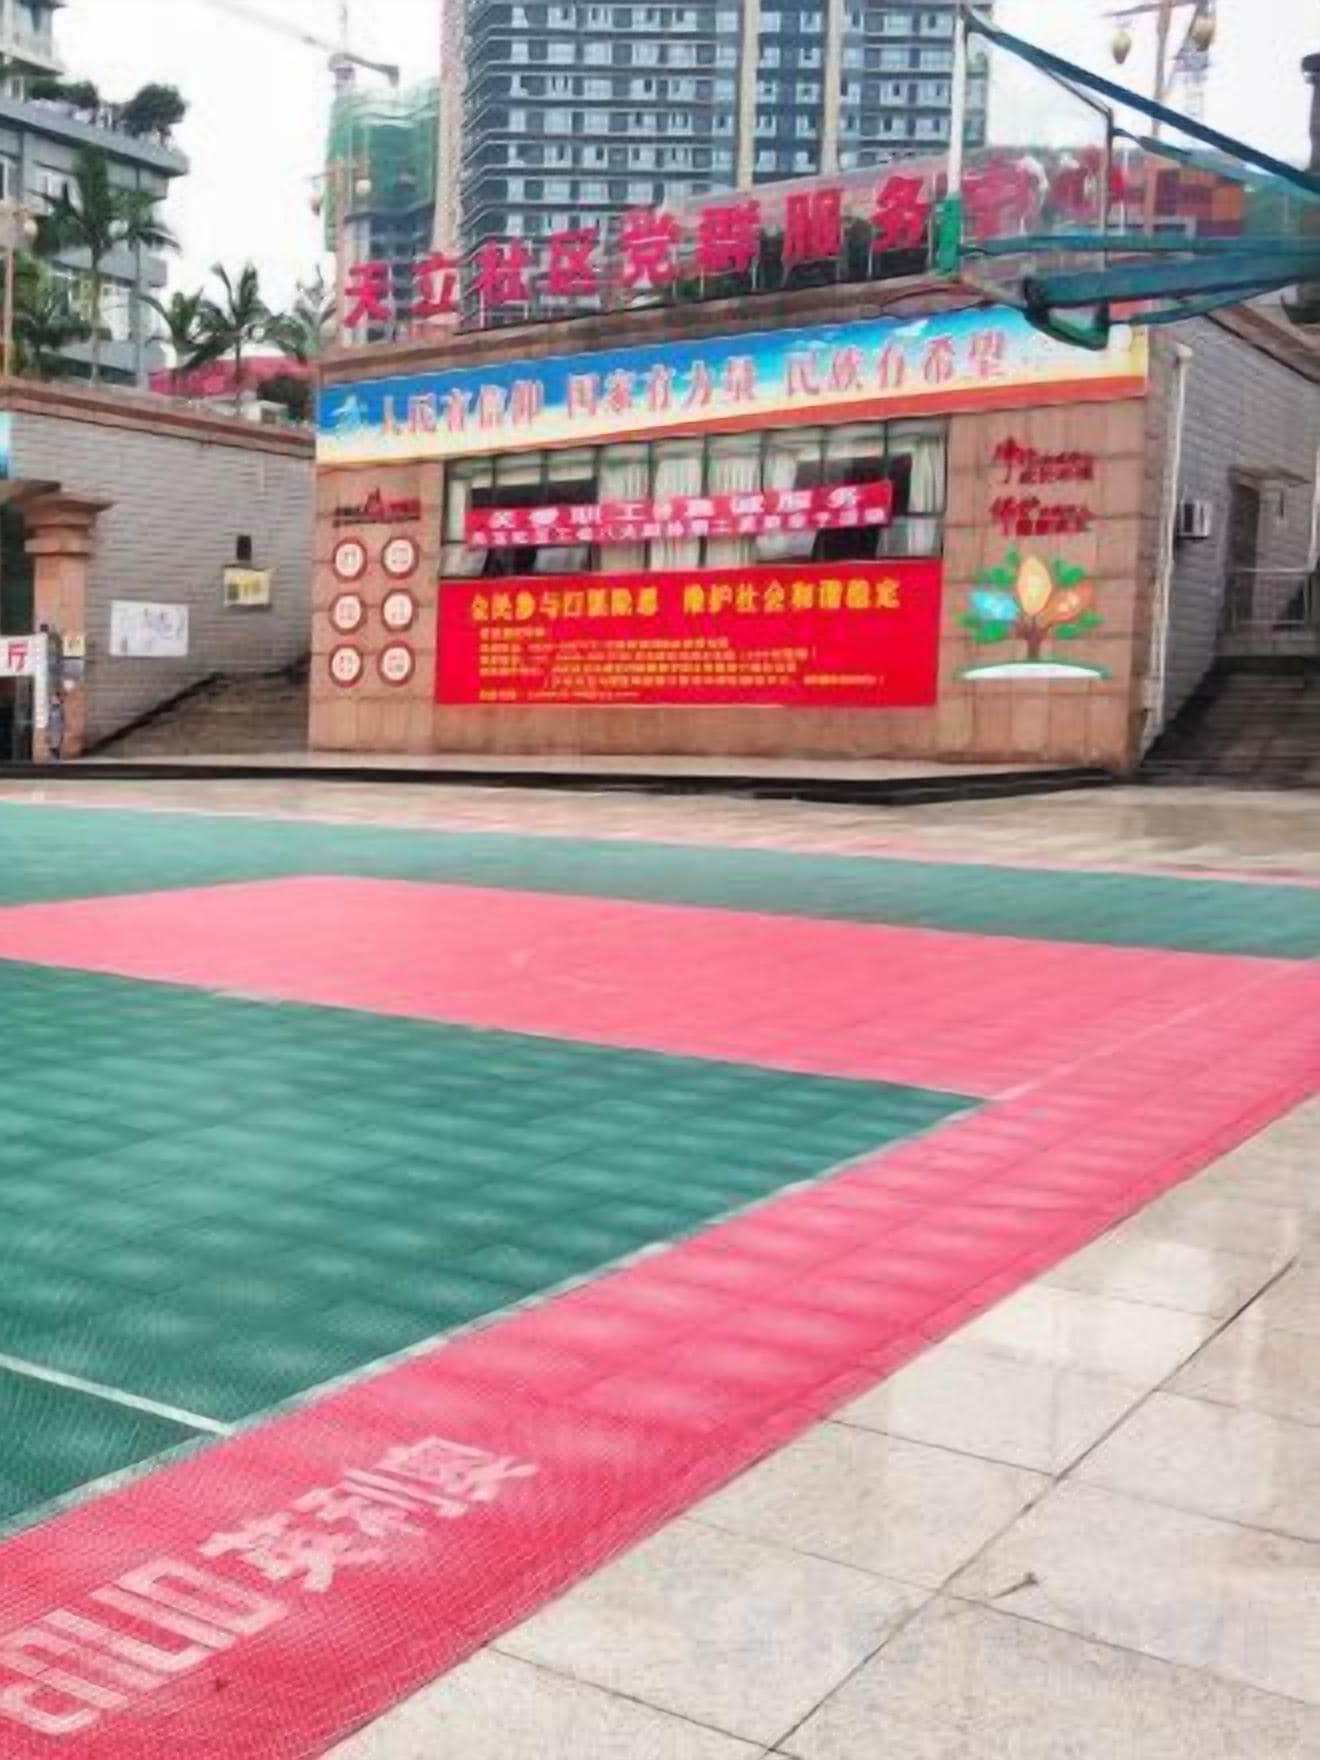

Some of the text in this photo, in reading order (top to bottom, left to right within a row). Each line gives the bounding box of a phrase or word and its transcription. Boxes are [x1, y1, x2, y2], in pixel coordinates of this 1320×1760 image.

[382, 330, 1007, 436] 人民有信仰 国家有力量 民族有希望
